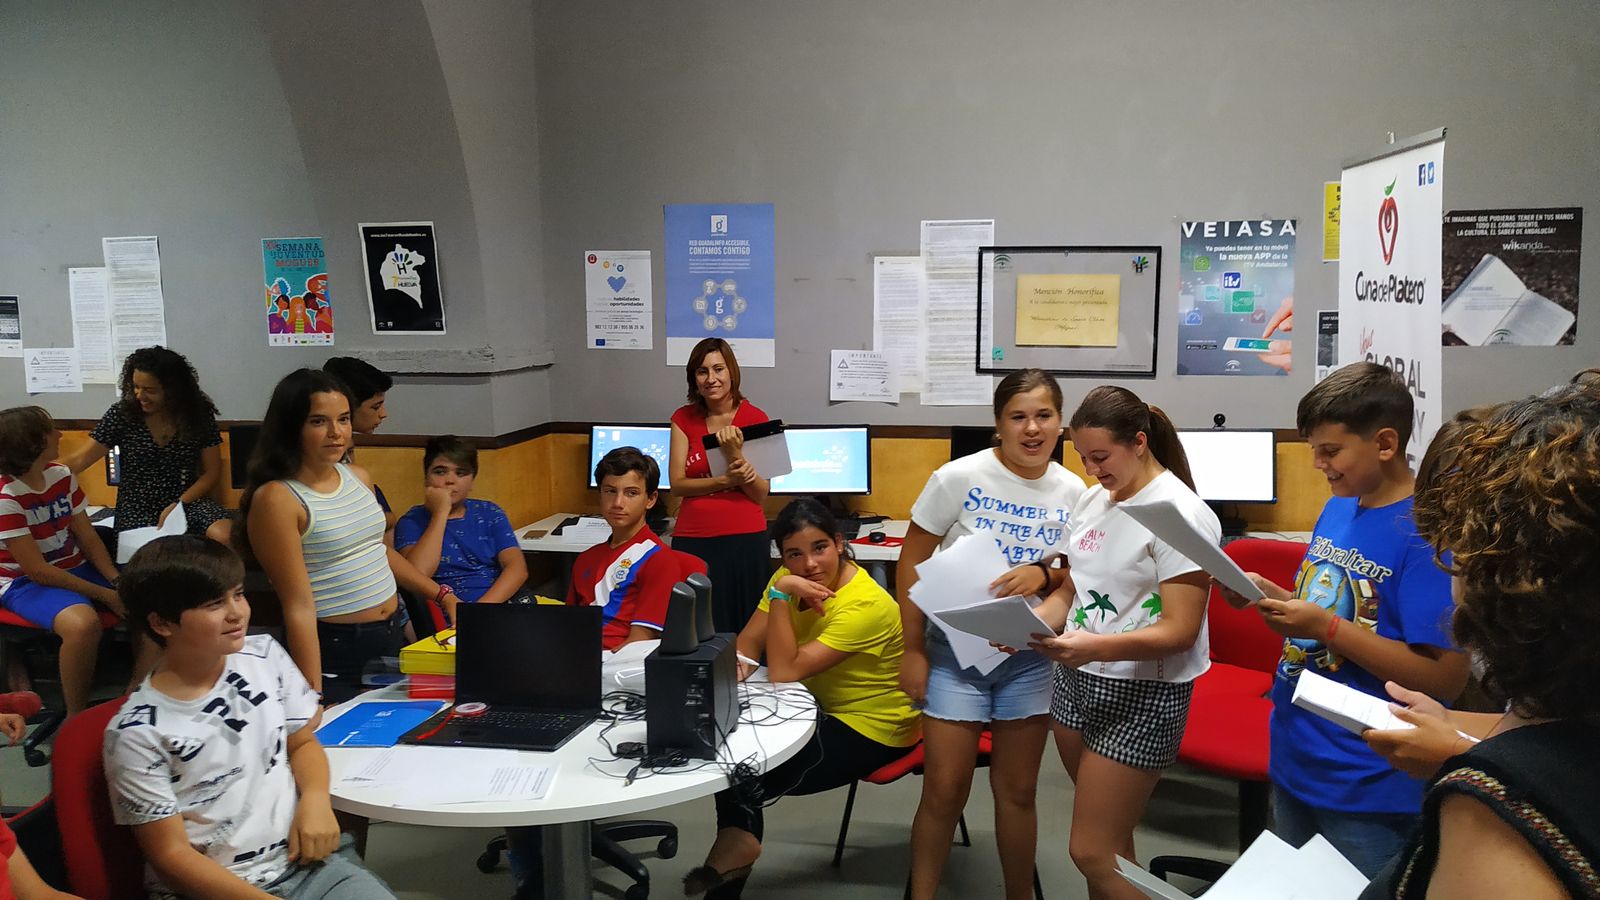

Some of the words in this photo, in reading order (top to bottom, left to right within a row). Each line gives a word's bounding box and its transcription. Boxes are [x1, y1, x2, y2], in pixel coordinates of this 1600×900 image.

[1452, 215, 1477, 223] IMAGINAS
[1489, 214, 1516, 222] PUDIERAS
[1535, 213, 1543, 221] EN
[1544, 213, 1554, 221] TUS
[1181, 220, 1296, 238] VEIASA
[1475, 221, 1490, 229] TODO
[1490, 221, 1497, 229] EL
[1456, 229, 1464, 237] LA
[276, 242, 320, 251] SEMANA
[688, 246, 722, 255] CONTAMOS
[722, 246, 751, 255] CONTIGO
[1213, 245, 1236, 253] puedes
[273, 249, 325, 259] JUVENTUD
[1219, 253, 1227, 261] la
[1253, 252, 1271, 260] APP
[1281, 252, 1288, 260] la
[964, 487, 1048, 520] SUMMER
[975, 517, 996, 530] IN
[1000, 521, 1033, 542] THE
